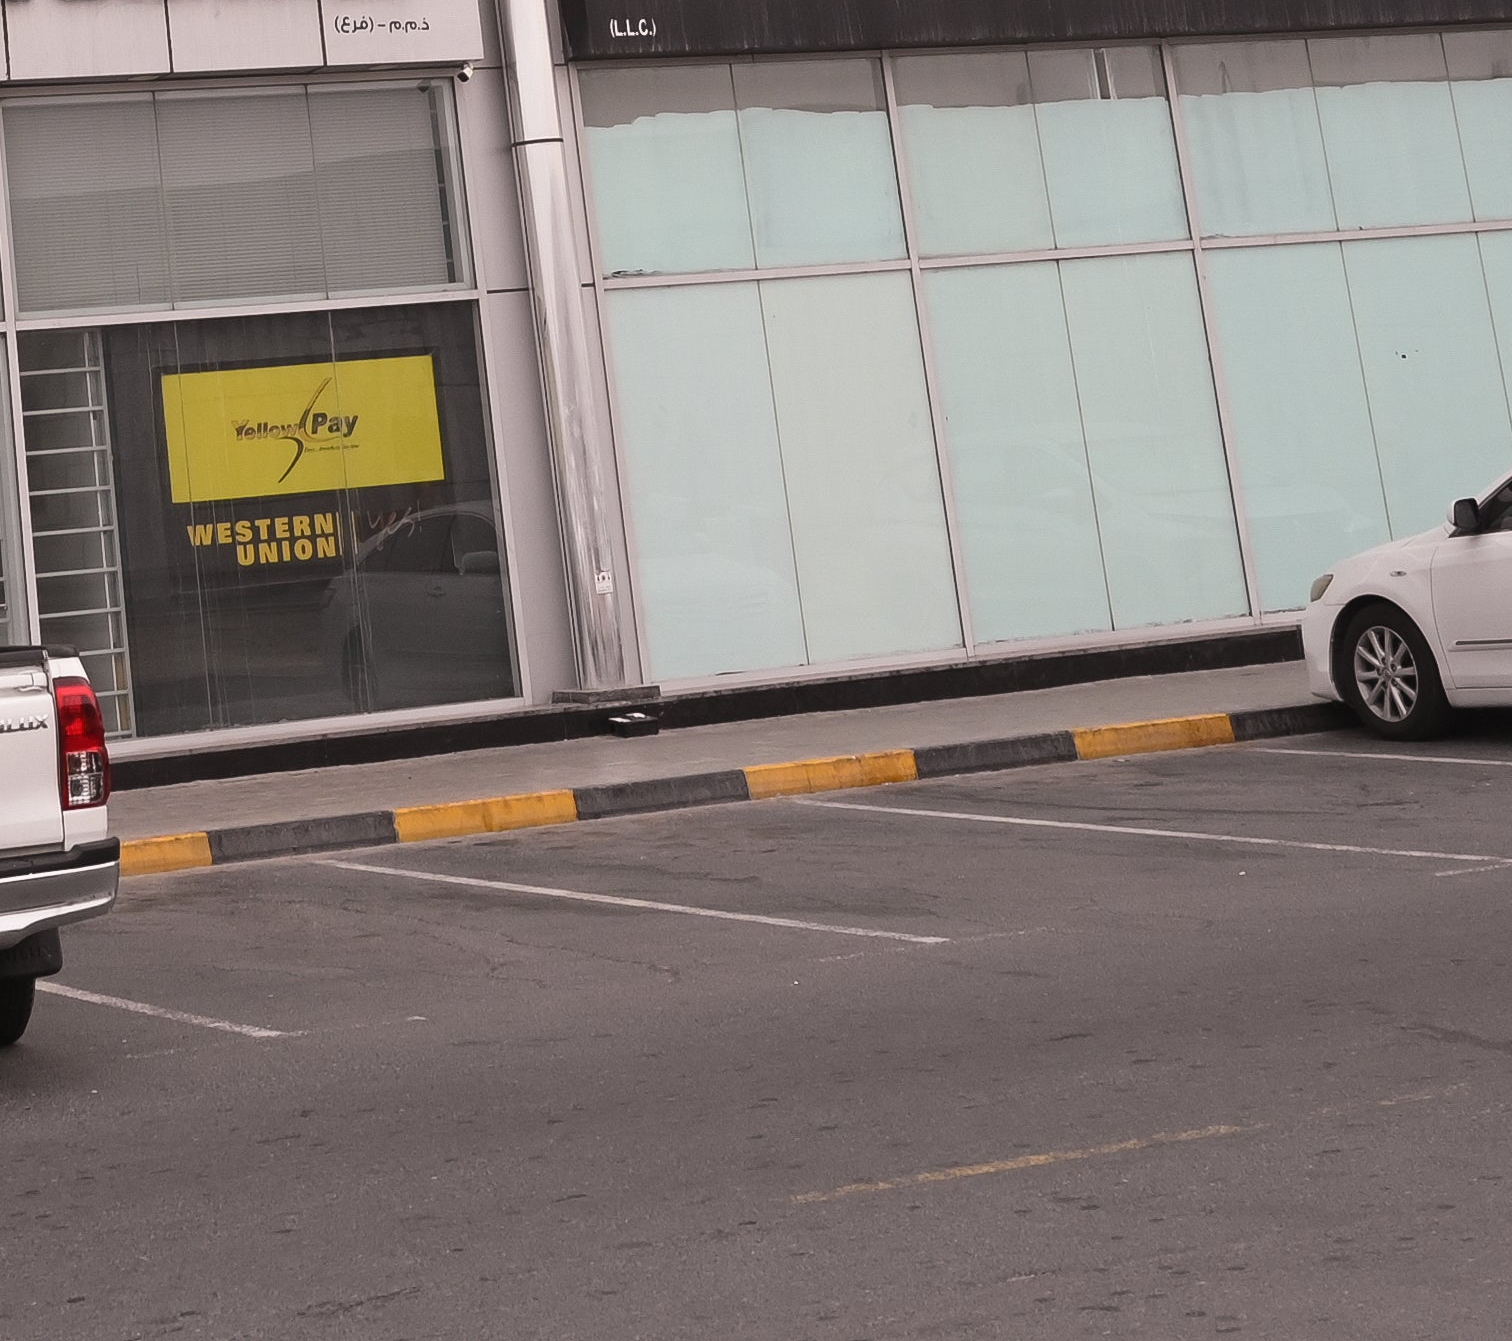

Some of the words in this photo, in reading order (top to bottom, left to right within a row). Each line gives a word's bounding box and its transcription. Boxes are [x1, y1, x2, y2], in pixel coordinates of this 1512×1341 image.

[230, 418, 305, 443] Yellow
[310, 410, 360, 439] Pay
[186, 511, 337, 548] WESTERN
[236, 535, 338, 568] UNION
